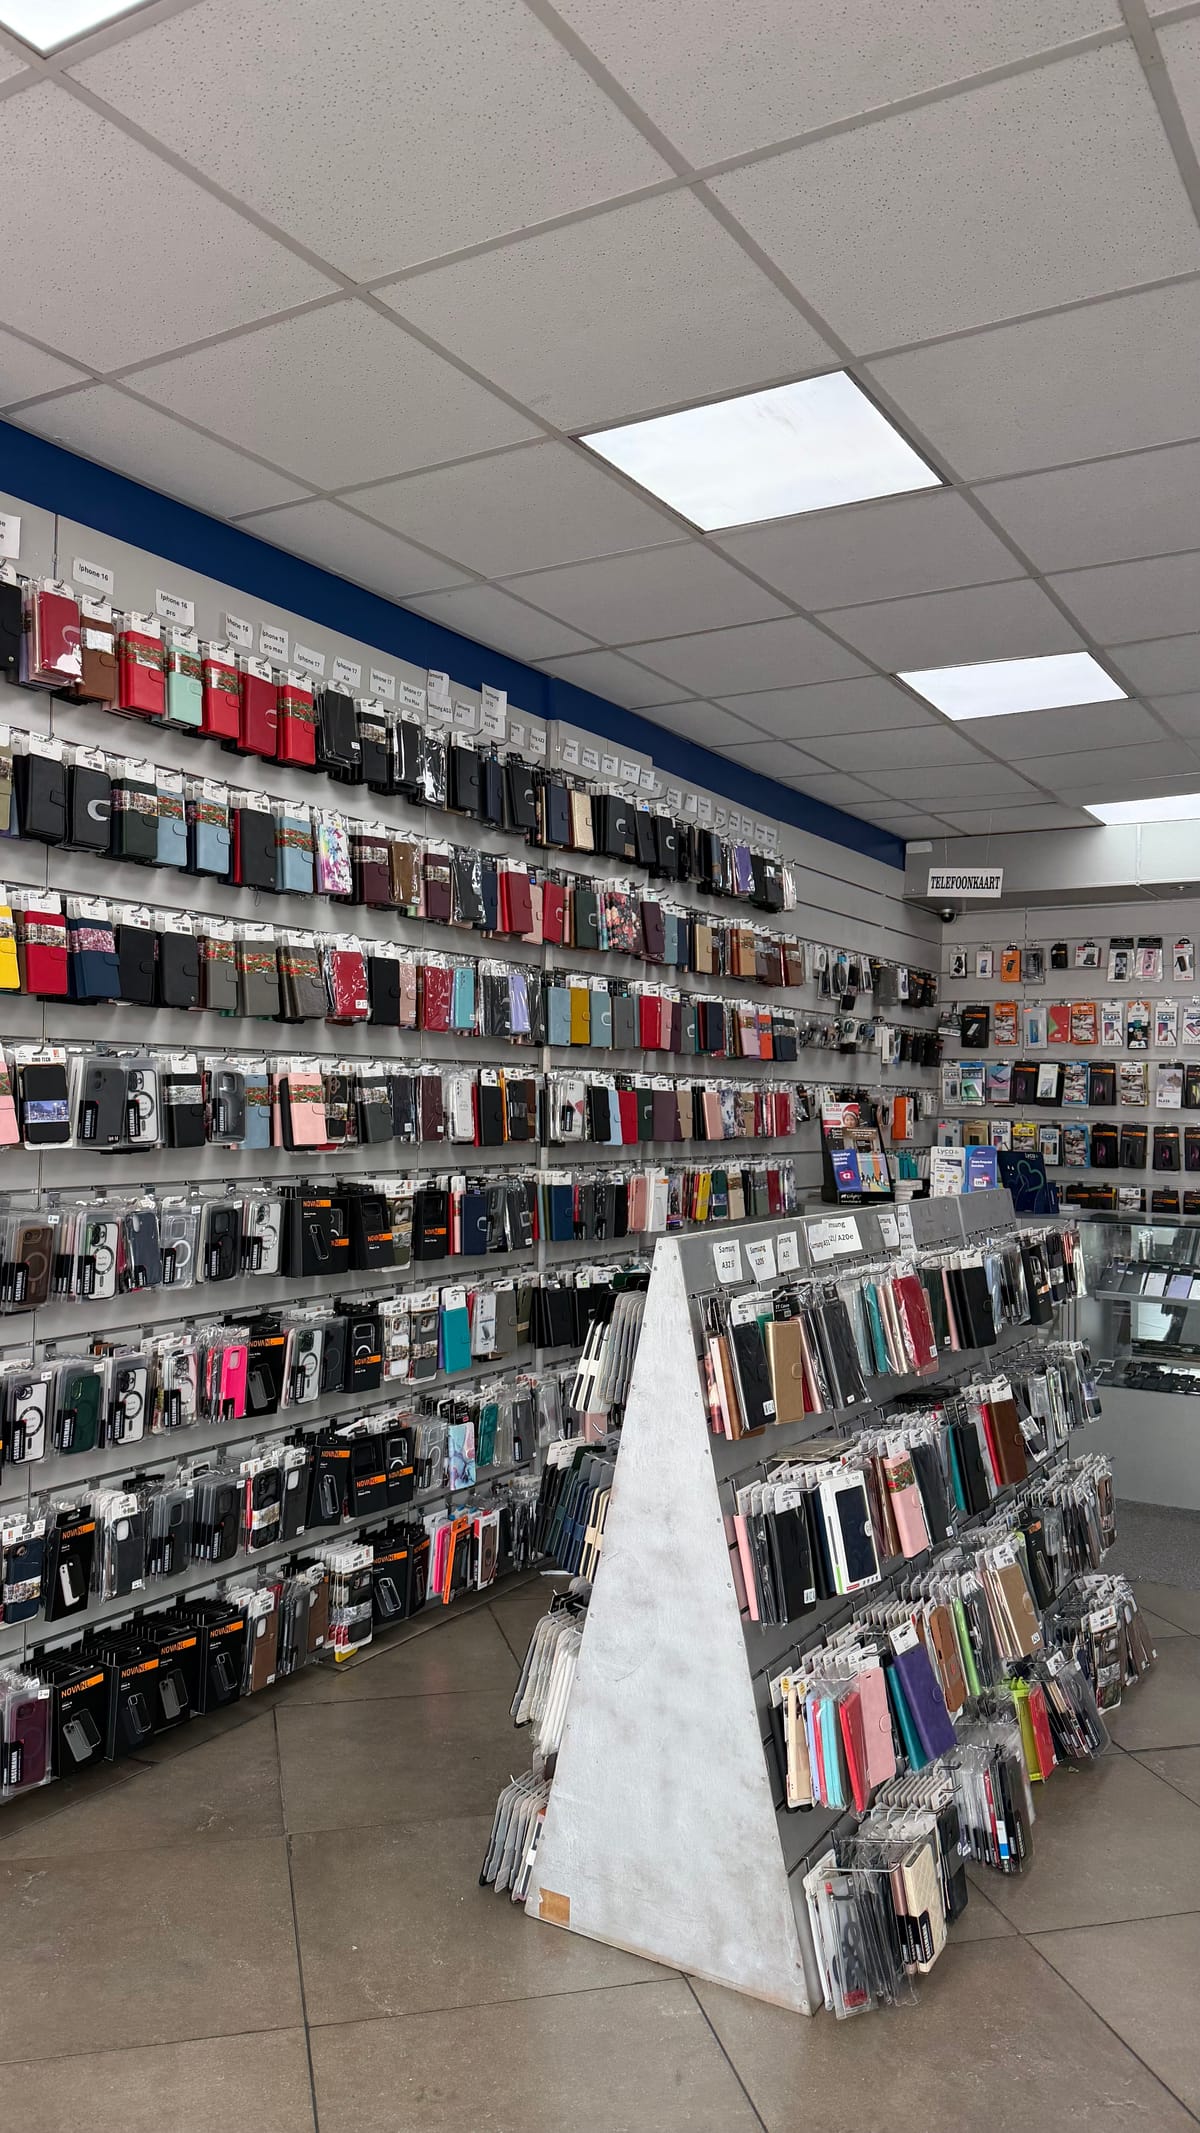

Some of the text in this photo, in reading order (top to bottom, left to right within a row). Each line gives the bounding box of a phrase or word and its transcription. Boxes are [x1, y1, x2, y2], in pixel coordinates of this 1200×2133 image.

[79, 564, 108, 581] Iphone 16
[160, 593, 188, 609] Iphone 16
[930, 875, 1001, 889] TELEFOONKAART
